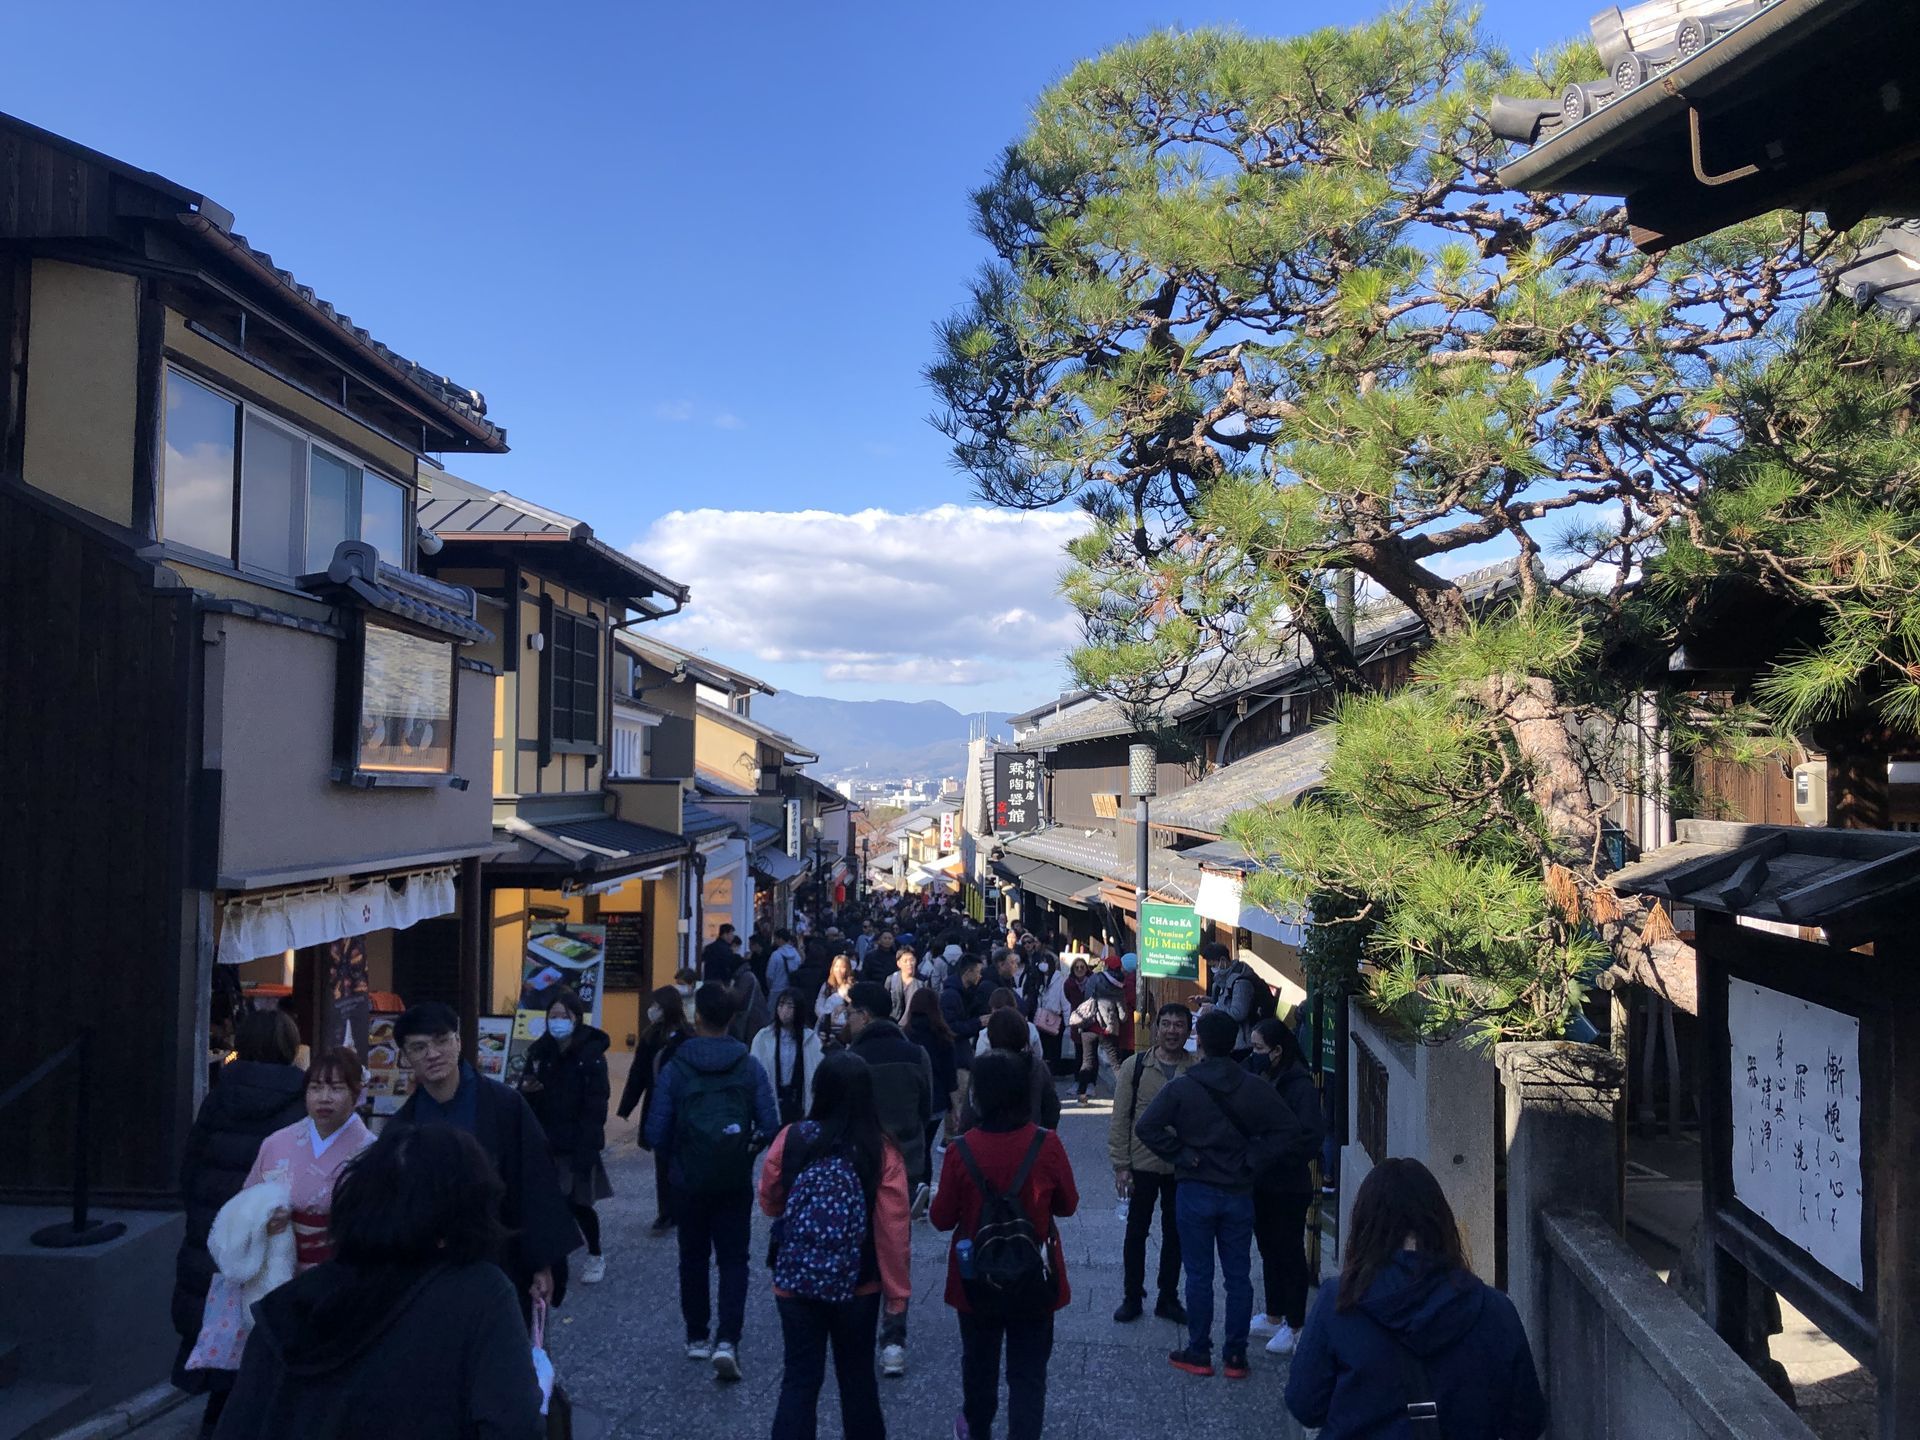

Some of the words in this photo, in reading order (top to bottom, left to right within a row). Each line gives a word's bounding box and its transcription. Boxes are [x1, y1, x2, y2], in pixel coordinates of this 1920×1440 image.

[1157, 929, 1184, 938] Premium
[1144, 936, 1158, 948] Uji
[1162, 938, 1197, 950] Matcha
